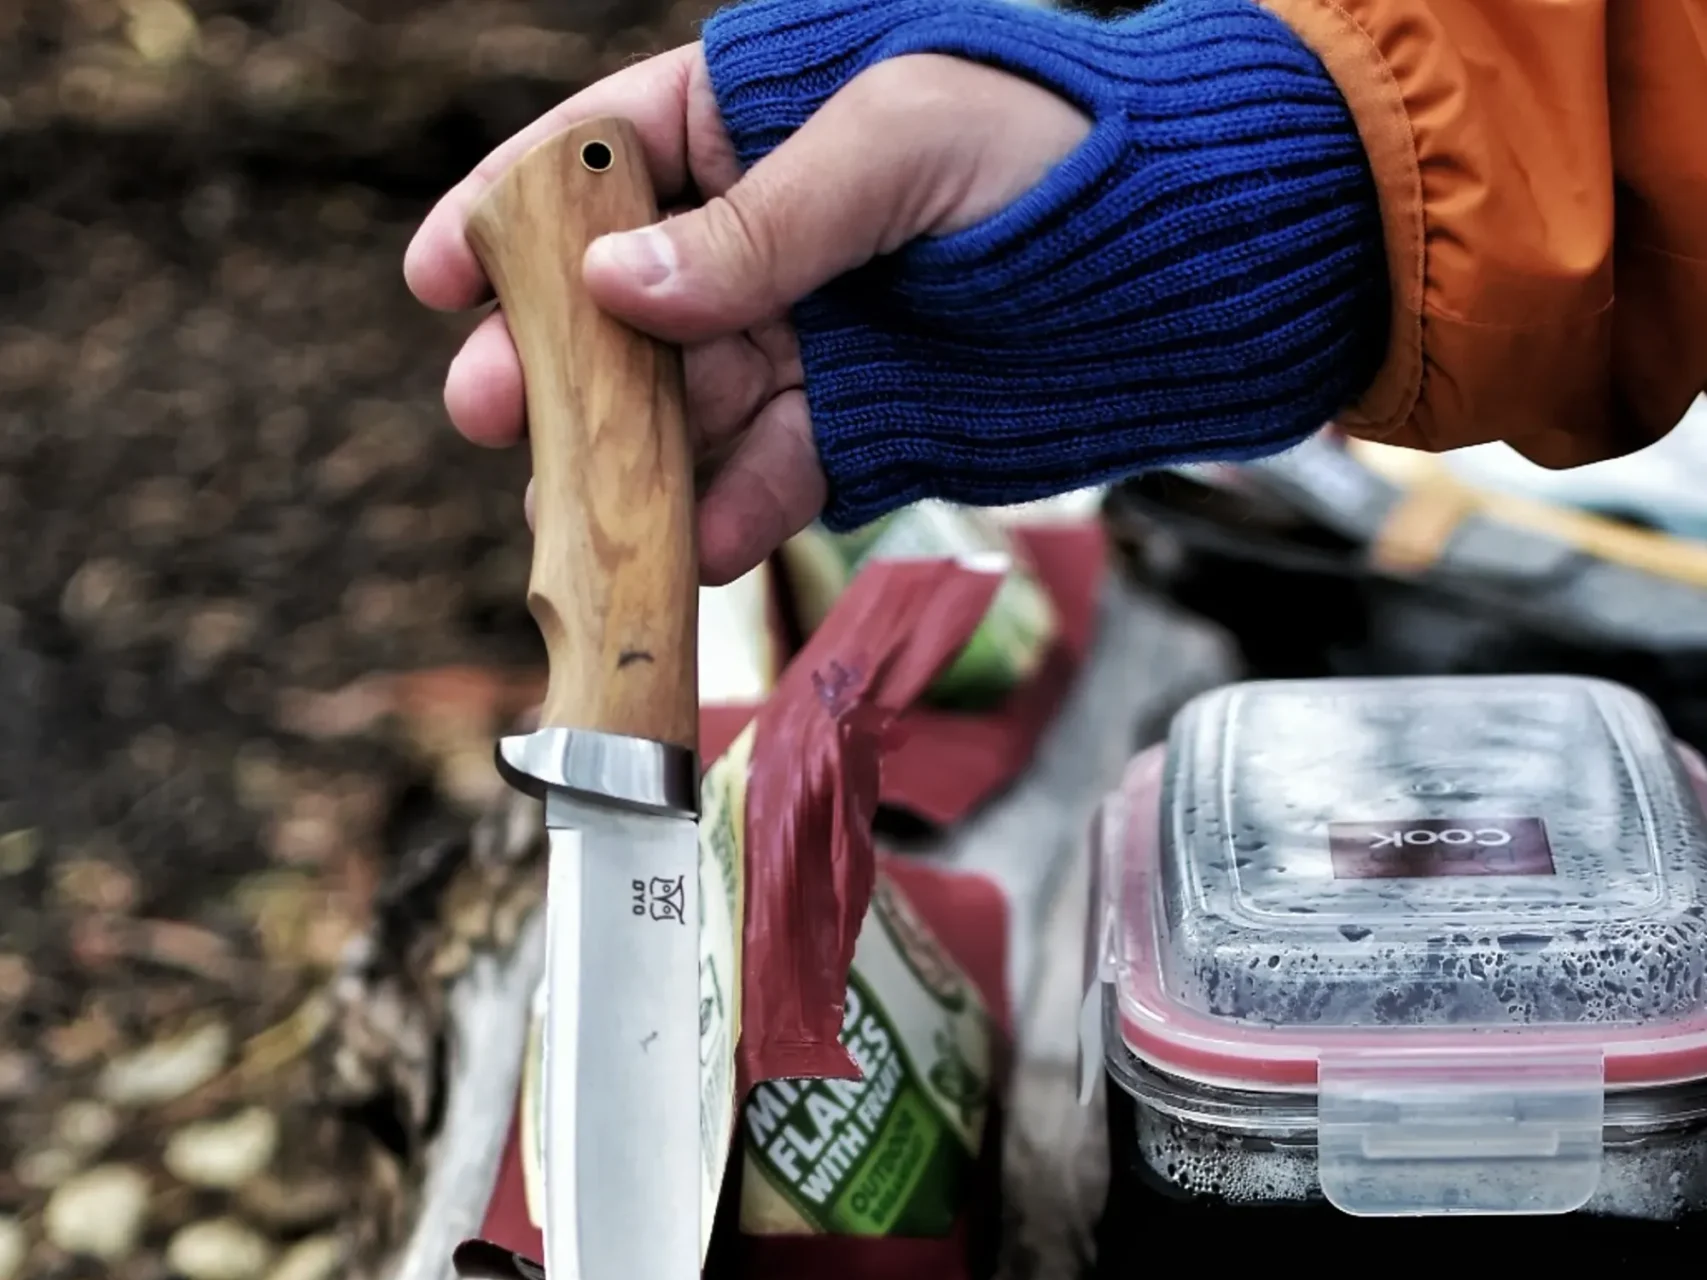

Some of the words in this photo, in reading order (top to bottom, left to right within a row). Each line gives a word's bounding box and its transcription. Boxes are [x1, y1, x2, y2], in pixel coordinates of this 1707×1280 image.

[1369, 828, 1512, 849] COOK
[800, 1122, 868, 1205] WITH
[857, 1052, 904, 1132] FRUIT
